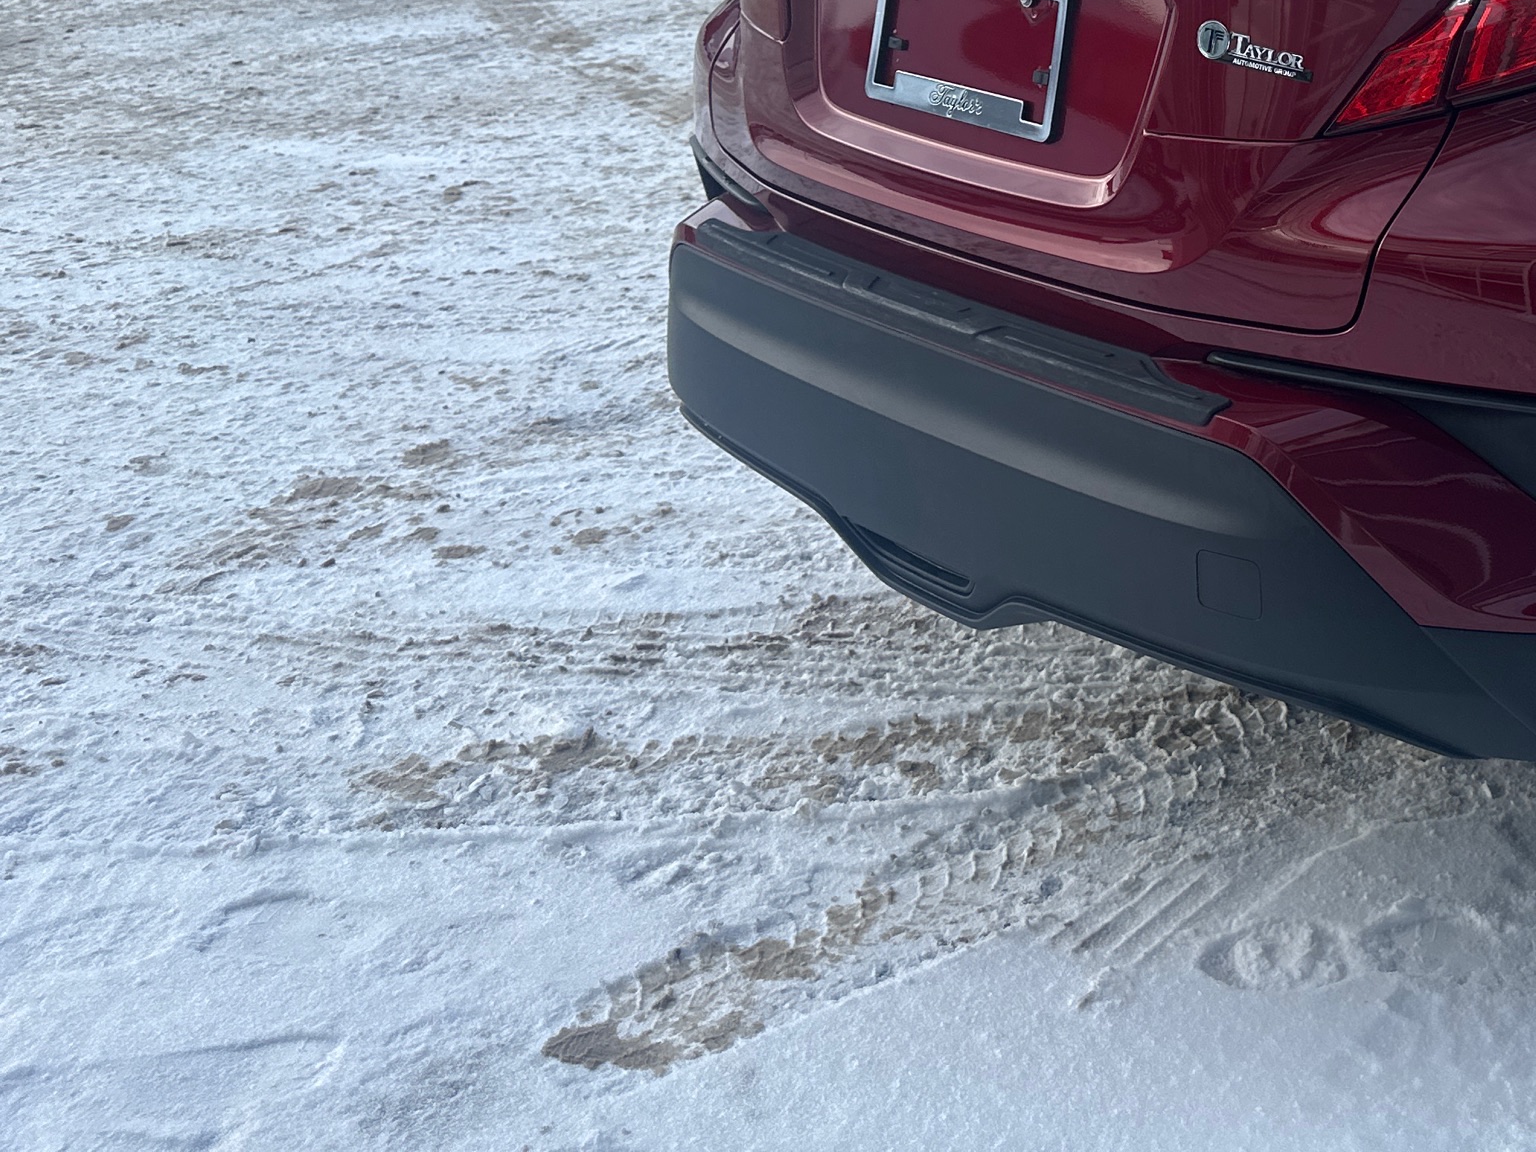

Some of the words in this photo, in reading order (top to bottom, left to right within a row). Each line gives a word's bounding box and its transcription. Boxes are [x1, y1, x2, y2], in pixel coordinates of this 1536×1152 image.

[1229, 31, 1305, 70] TAYLOR
[1232, 57, 1274, 73] AUTOMOTIVE
[1273, 66, 1297, 79] GROUP
